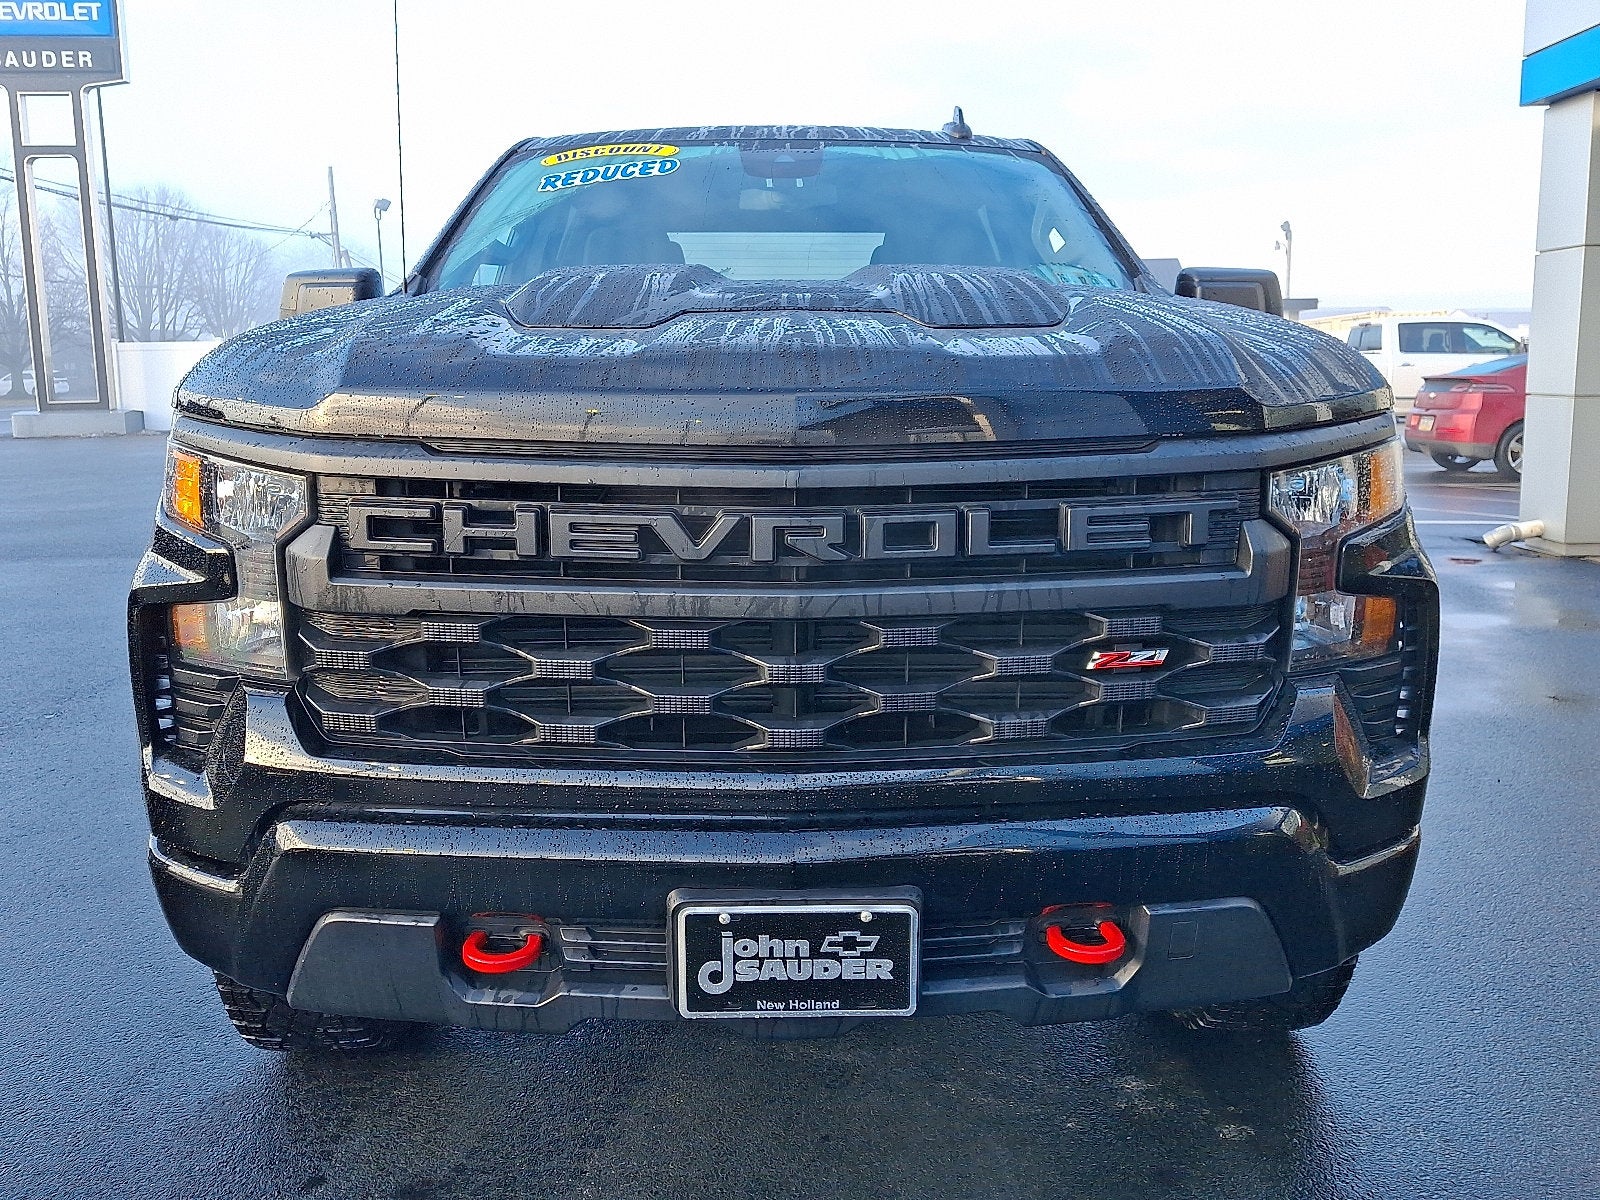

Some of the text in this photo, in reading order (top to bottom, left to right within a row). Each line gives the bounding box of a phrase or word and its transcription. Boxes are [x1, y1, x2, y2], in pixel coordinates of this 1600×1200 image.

[0, 2, 102, 21] EVROLET
[0, 50, 93, 68] AUDER
[556, 146, 664, 162] DISCOUNT
[540, 158, 678, 190] REDUCED
[348, 499, 1238, 563] CHEVROLET
[1086, 649, 1169, 670] Z71
[735, 958, 894, 982] SAUDER
[756, 999, 840, 1010] New Holland
